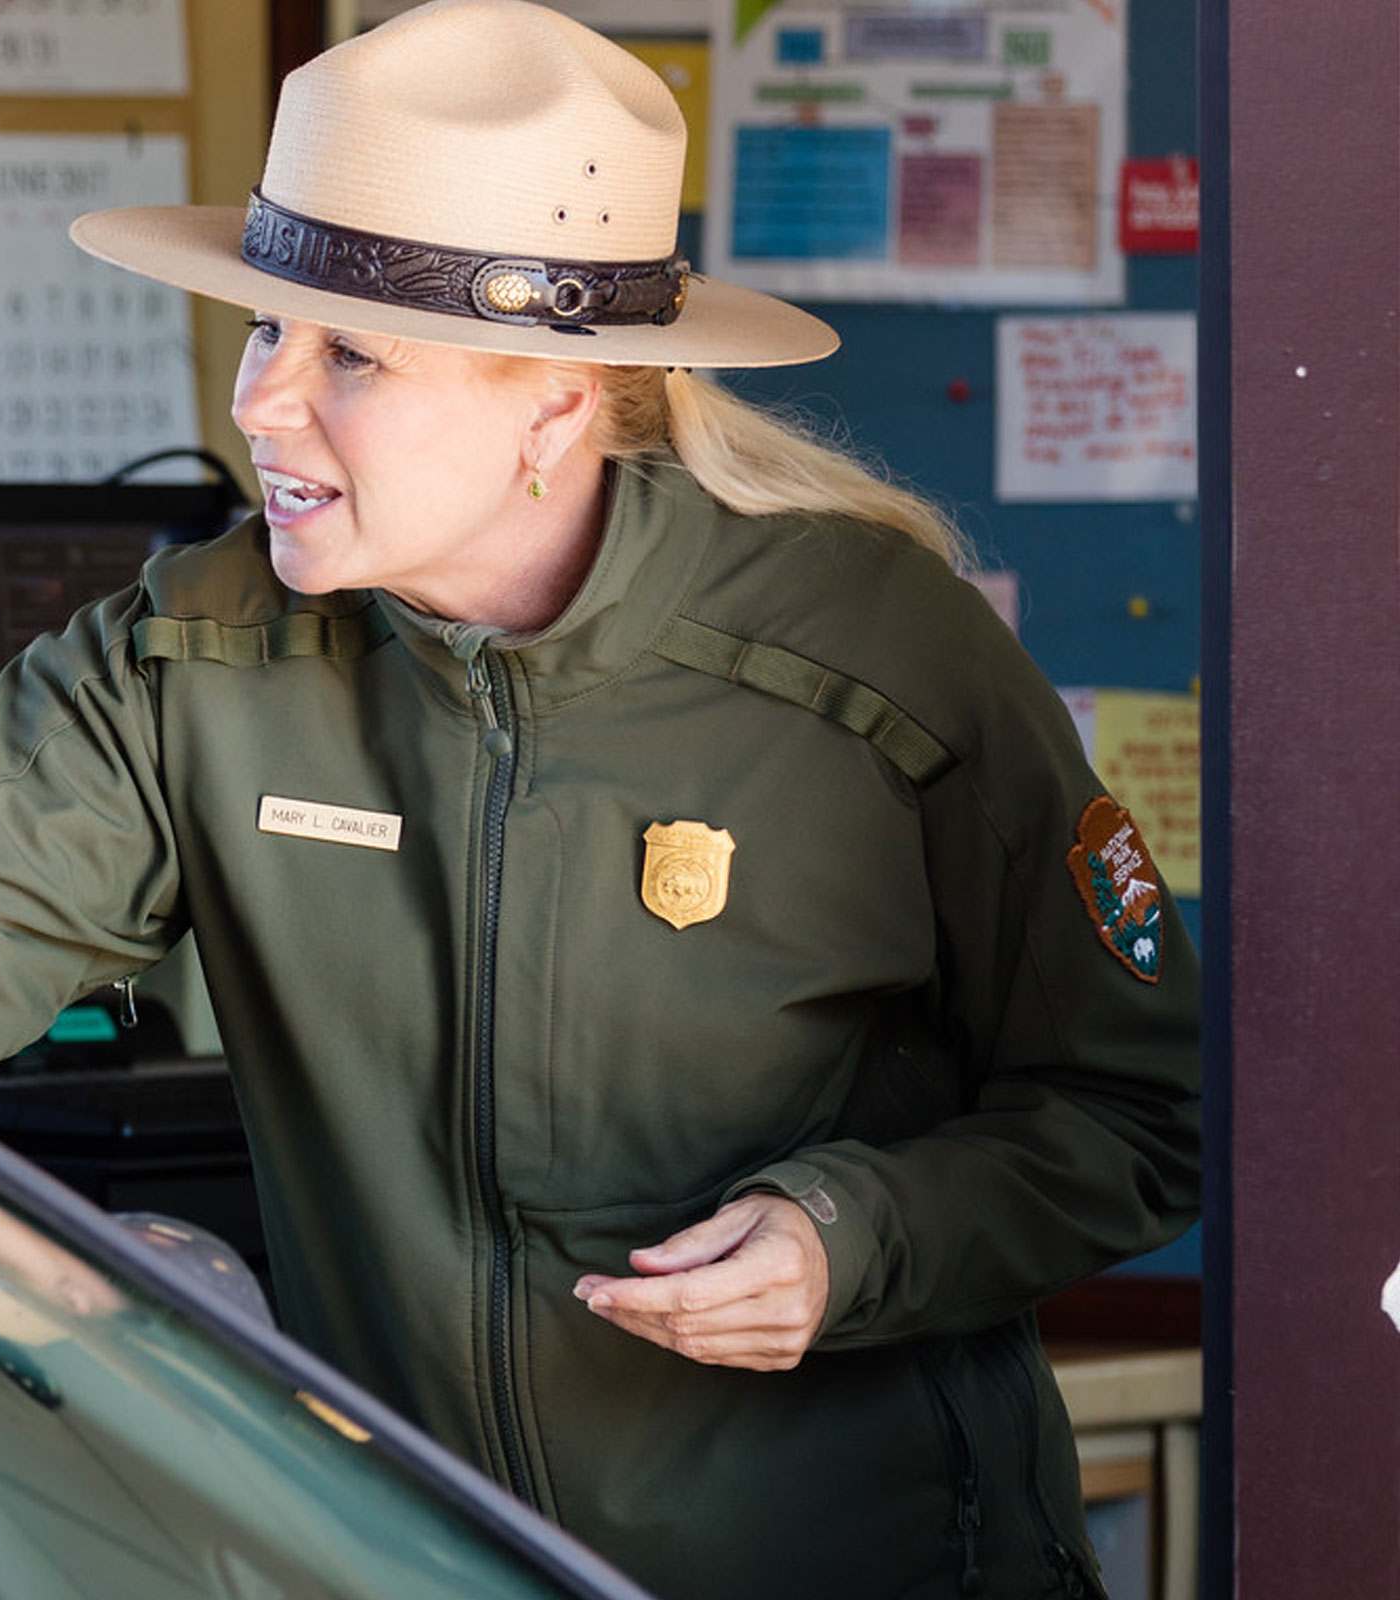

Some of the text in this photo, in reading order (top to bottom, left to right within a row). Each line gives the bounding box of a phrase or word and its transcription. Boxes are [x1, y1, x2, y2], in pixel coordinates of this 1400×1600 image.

[272, 808, 306, 825] MARY
[331, 816, 388, 838] CAVALIER
[1112, 843, 1131, 868] PARK
[1114, 850, 1143, 886] SERVICE
